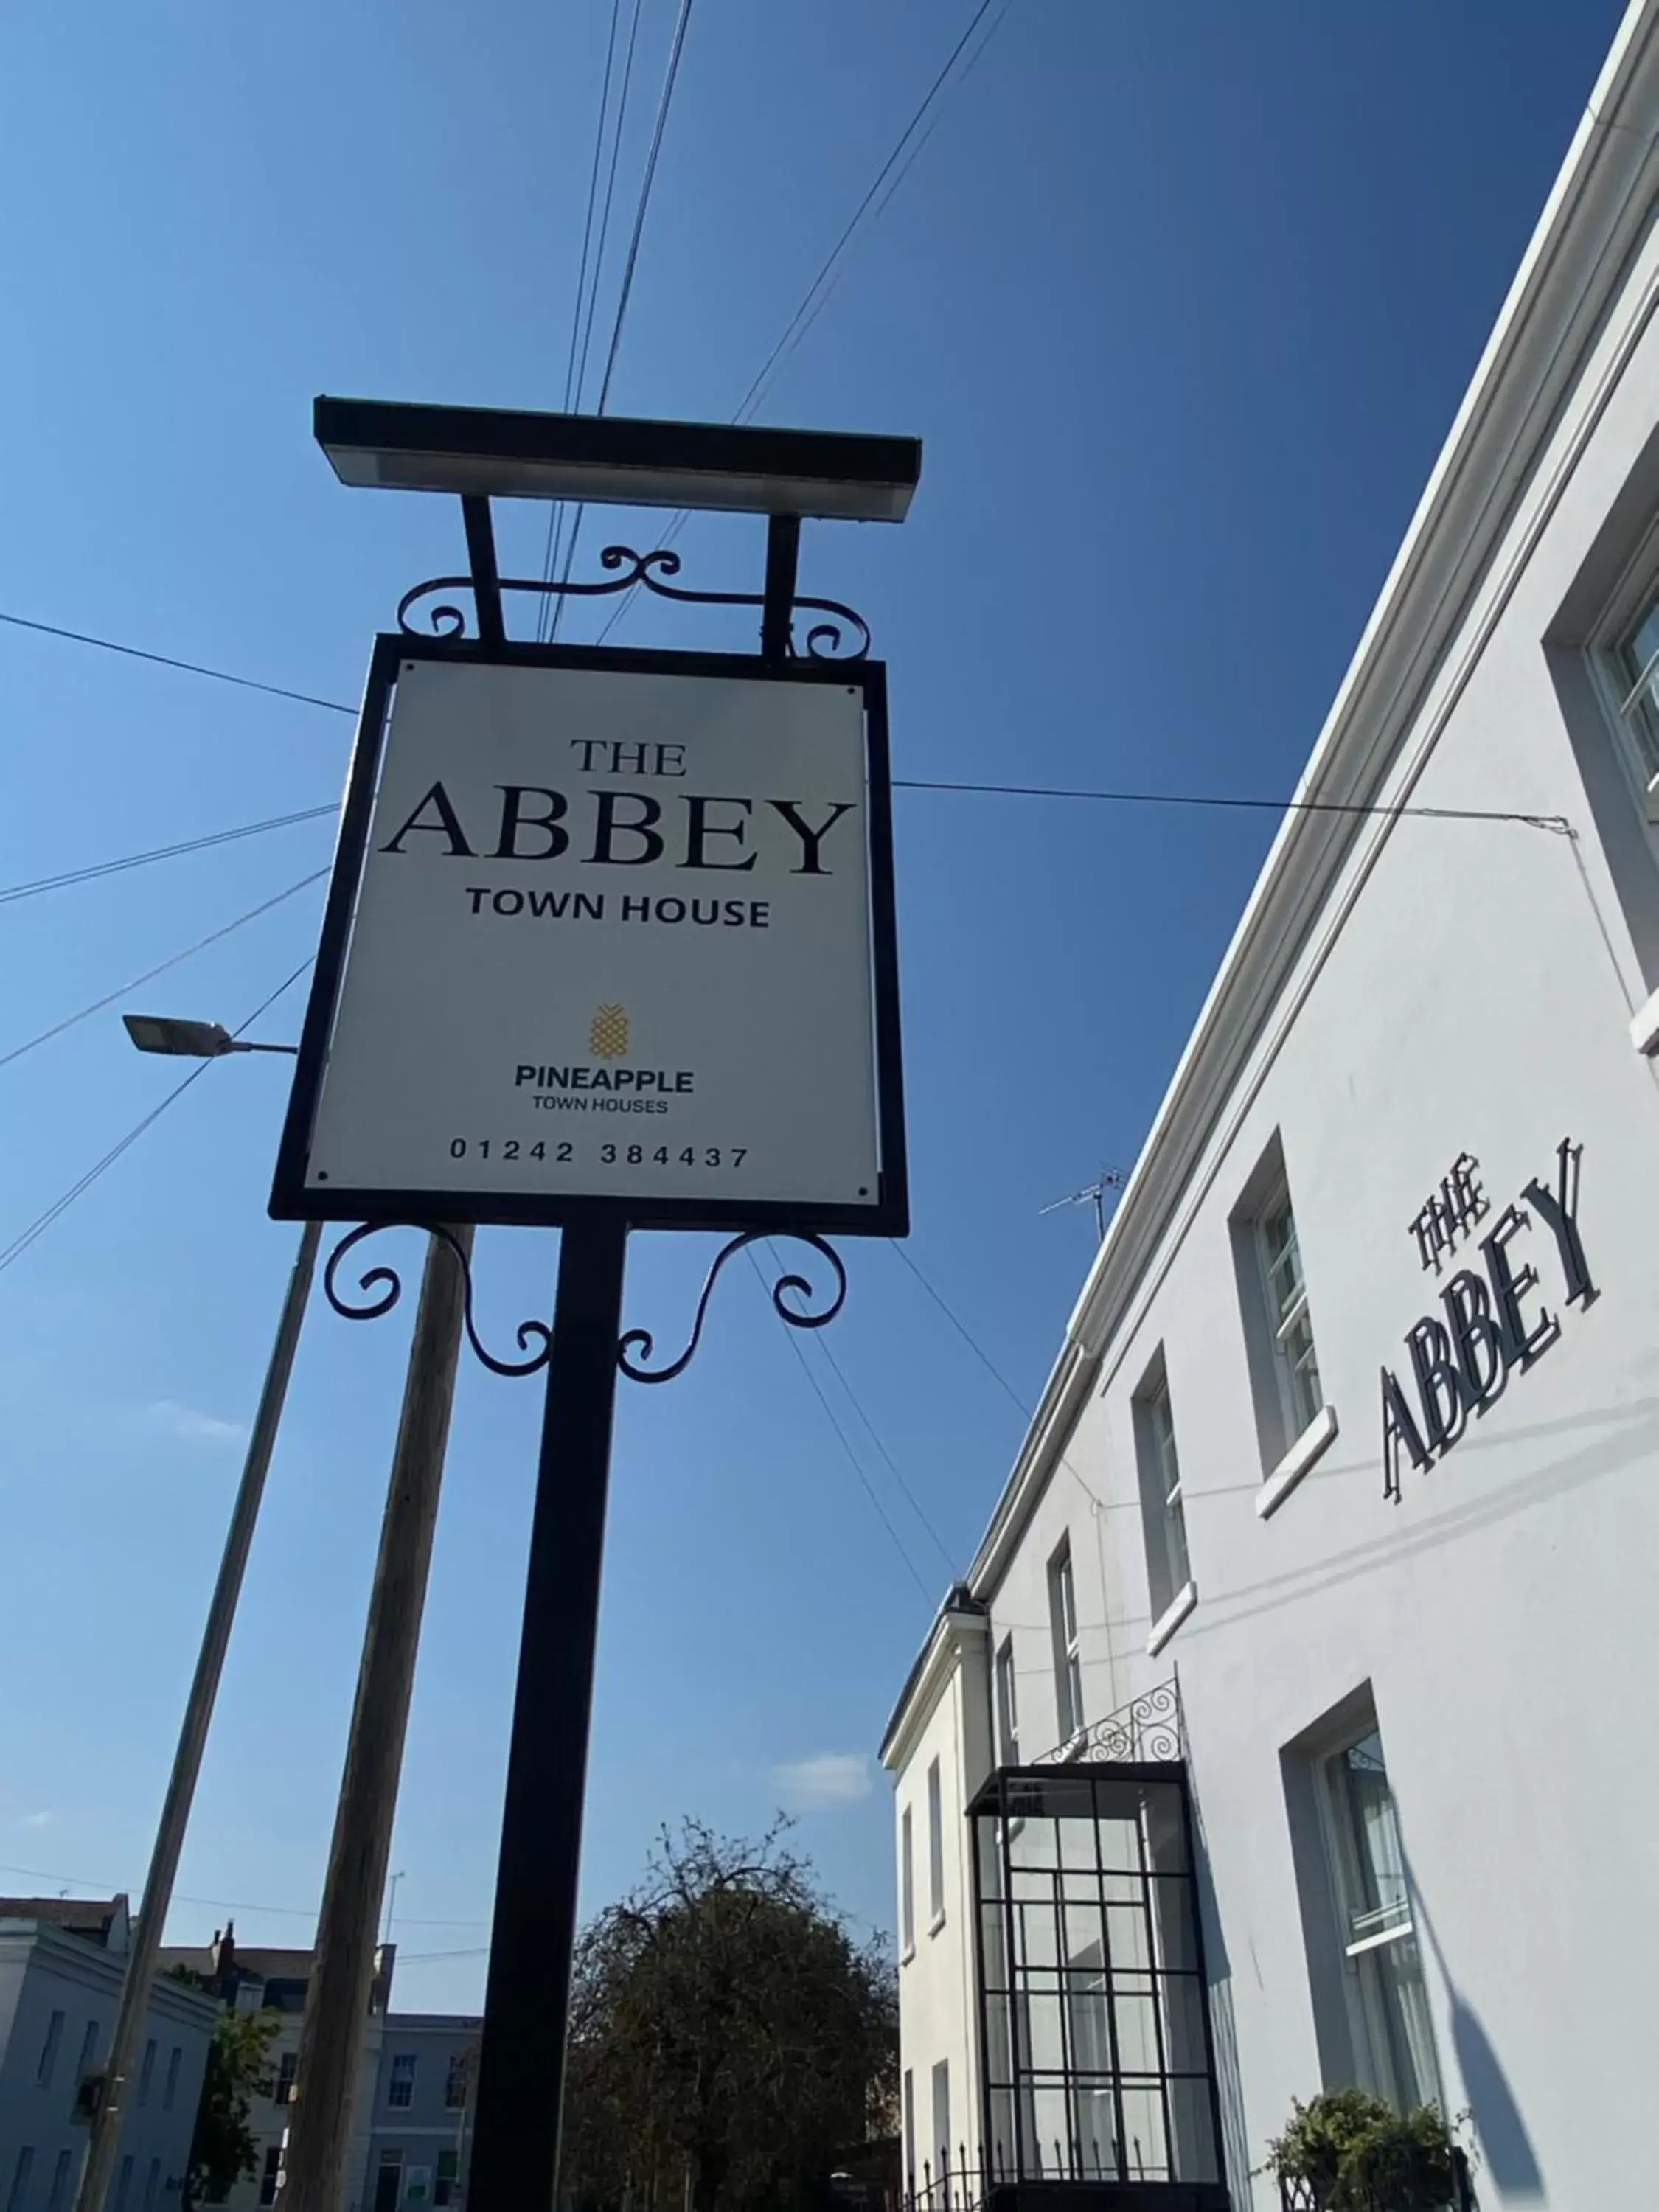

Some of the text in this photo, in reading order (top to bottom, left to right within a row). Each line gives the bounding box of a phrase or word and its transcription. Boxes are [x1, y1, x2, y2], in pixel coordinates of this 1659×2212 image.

[570, 739, 687, 778] THE
[378, 781, 858, 876] ABBEY
[465, 887, 771, 928] TOWN HOUSE
[515, 1065, 695, 1093] PINEAPPLE
[532, 1095, 669, 1115] TOWN HOUSES
[449, 1137, 748, 1168] 01242 384437
[1408, 1152, 1491, 1277] THE
[1382, 1137, 1601, 1505] ABBEY
